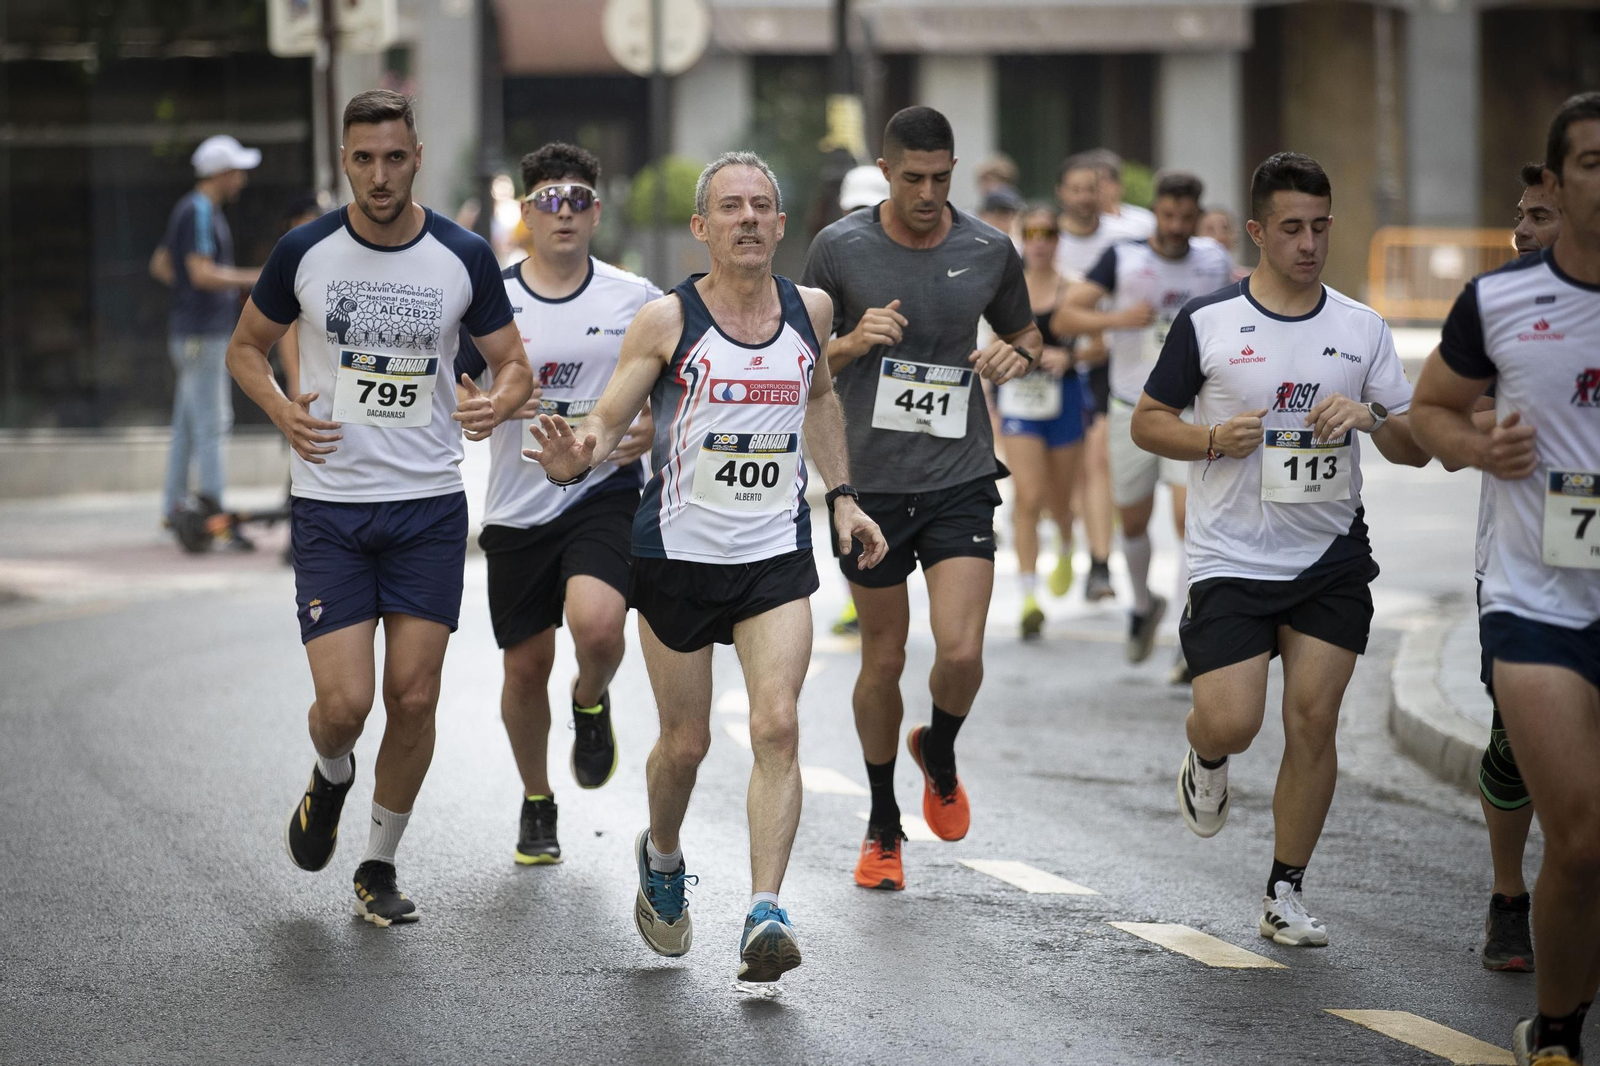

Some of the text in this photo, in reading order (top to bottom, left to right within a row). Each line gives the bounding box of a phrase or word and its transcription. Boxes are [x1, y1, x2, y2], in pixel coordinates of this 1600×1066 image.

[365, 294, 398, 302] Nacional
[399, 295, 409, 303] de
[391, 287, 436, 299] Campeonato
[380, 305, 436, 321] ALCZB22
[1229, 356, 1267, 365] Santander
[1341, 352, 1362, 363] mupol
[386, 357, 430, 373] GRANADA
[357, 379, 418, 407] 795
[749, 383, 800, 391] CONSTRUCCIONES
[749, 390, 799, 402] OTERO
[895, 388, 950, 416] 441
[366, 408, 406, 419] DACARANASA
[747, 434, 790, 450] GRANADA
[715, 460, 780, 488] 400
[1283, 456, 1337, 481] 113
[1304, 484, 1321, 493] JAVIER
[734, 492, 762, 501] ALBERTO
[1571, 508, 1600, 540] 7
